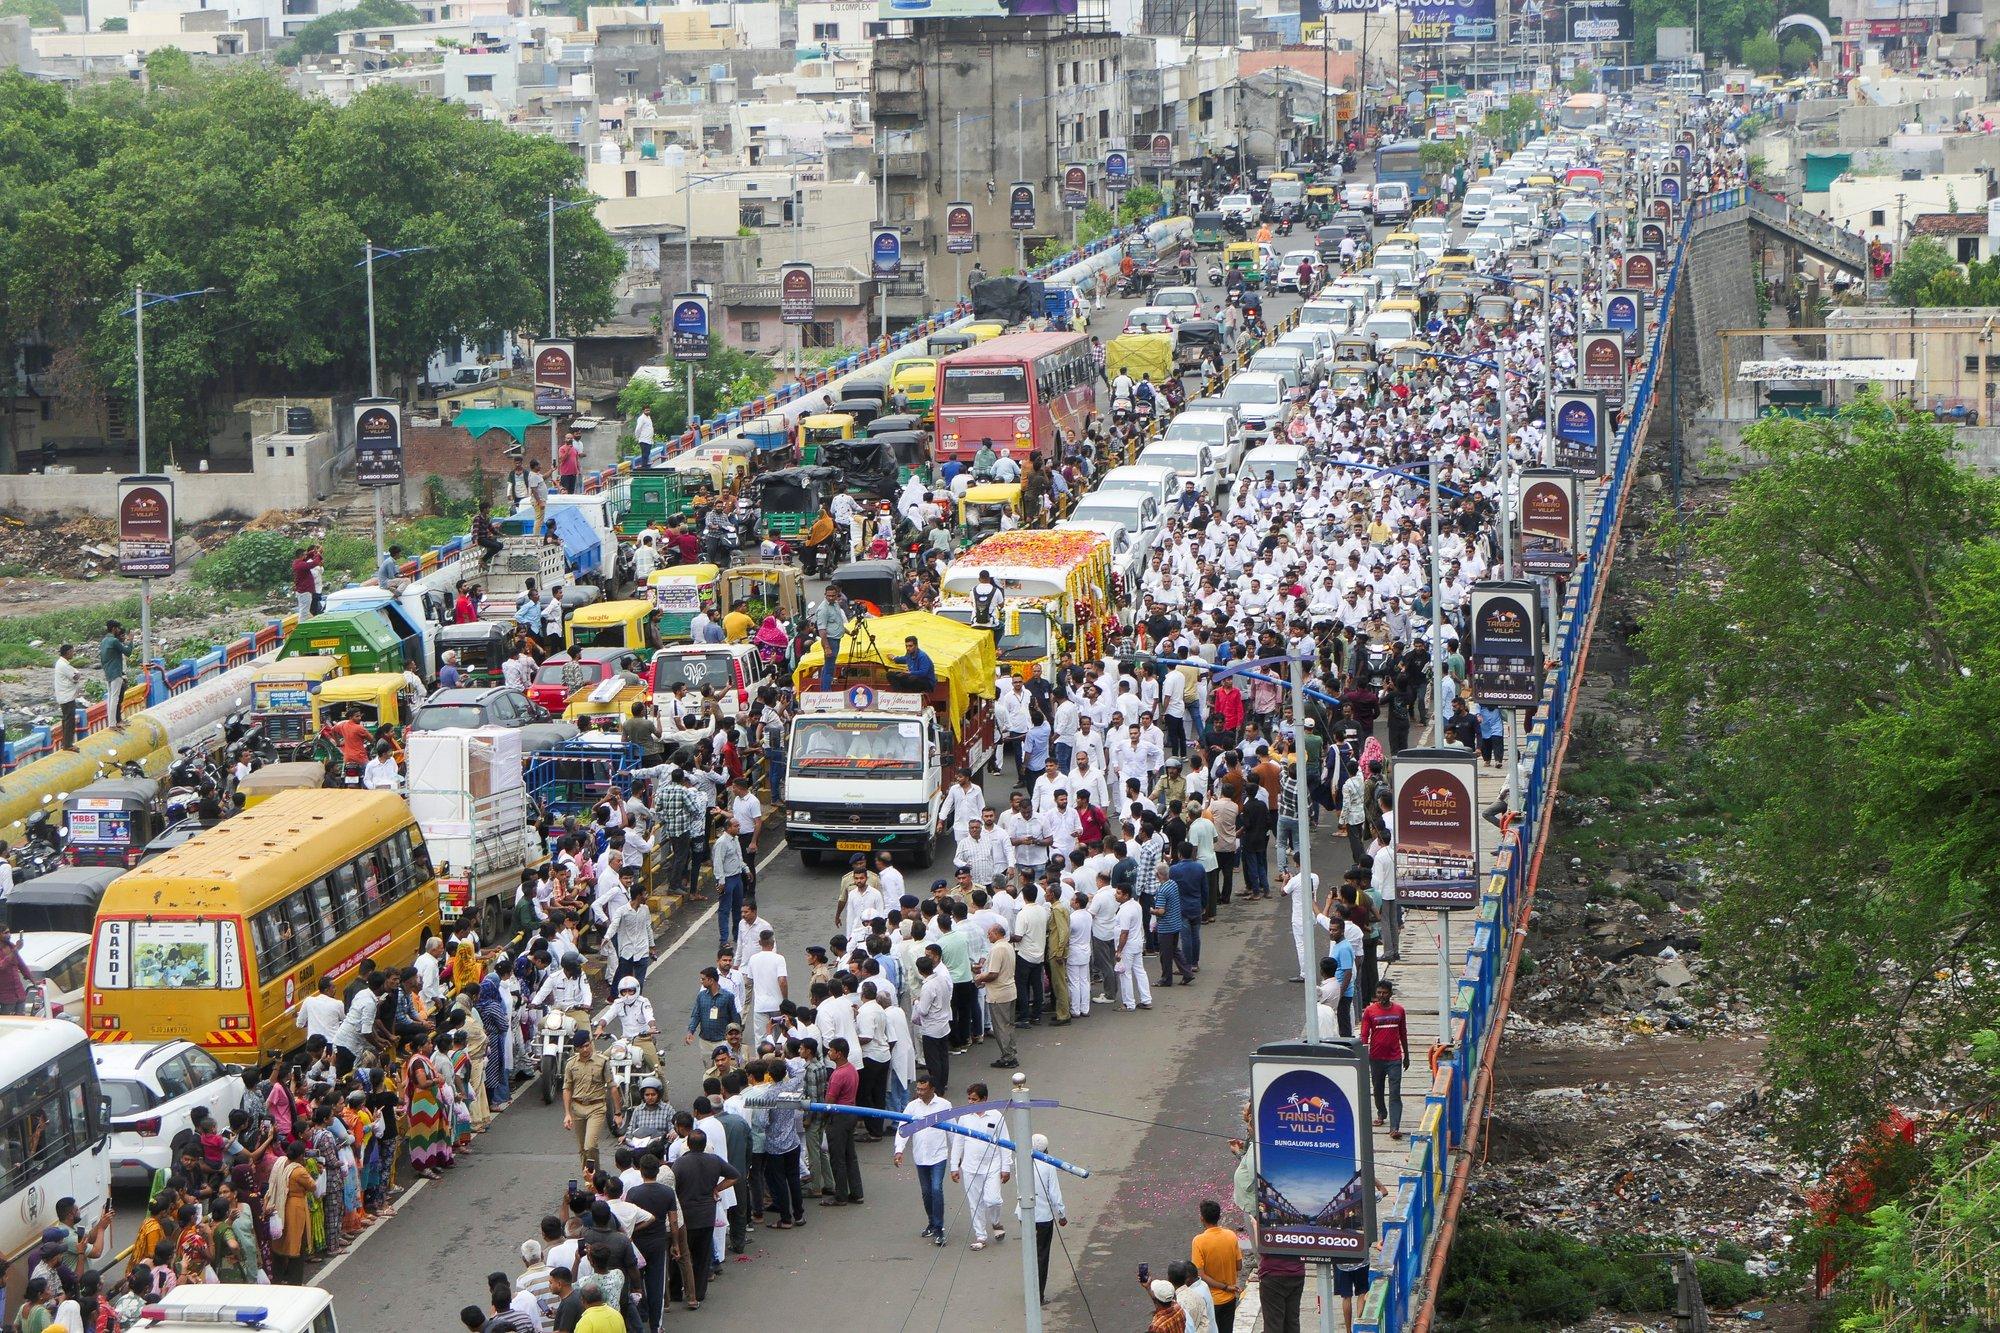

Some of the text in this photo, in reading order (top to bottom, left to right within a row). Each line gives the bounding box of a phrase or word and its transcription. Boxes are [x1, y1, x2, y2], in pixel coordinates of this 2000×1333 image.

[1412, 800, 1457, 808] TANISHQ
[1408, 890, 1472, 899] 84900 30200
[109, 923, 120, 986] GARDI
[224, 923, 233, 986] VIDYAPITH
[1277, 1111, 1335, 1124] TANISHQ
[1290, 1124, 1324, 1134] VILLA
[1274, 1139, 1313, 1148] BUNGALOWS
[1275, 1234, 1358, 1247] 84900 30200
